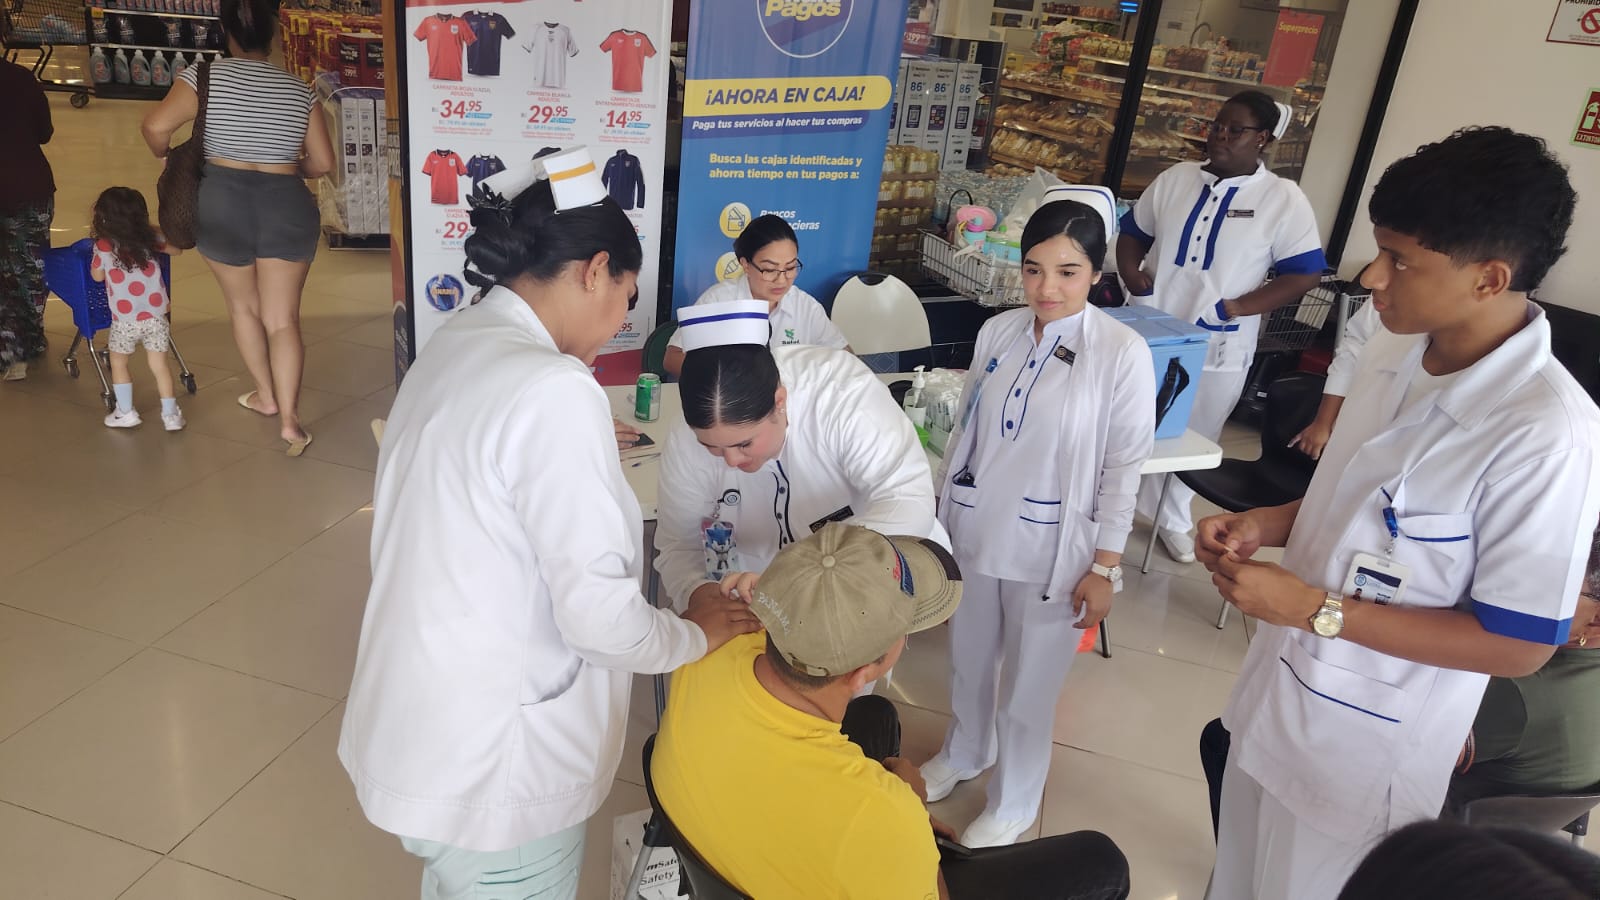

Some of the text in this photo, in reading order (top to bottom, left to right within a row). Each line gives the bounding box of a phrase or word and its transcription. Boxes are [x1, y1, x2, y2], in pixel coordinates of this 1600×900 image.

[764, 0, 841, 21] Pagos
[705, 86, 866, 106] ¡AHORA EN CAJA!
[692, 116, 862, 131] Paga tus servicios al hacer tus compras
[709, 153, 863, 168] Busca las cajas identificadas y
[709, 168, 860, 181] ahorra tiempo en tus pagos a:
[640, 871, 674, 886] Safety
